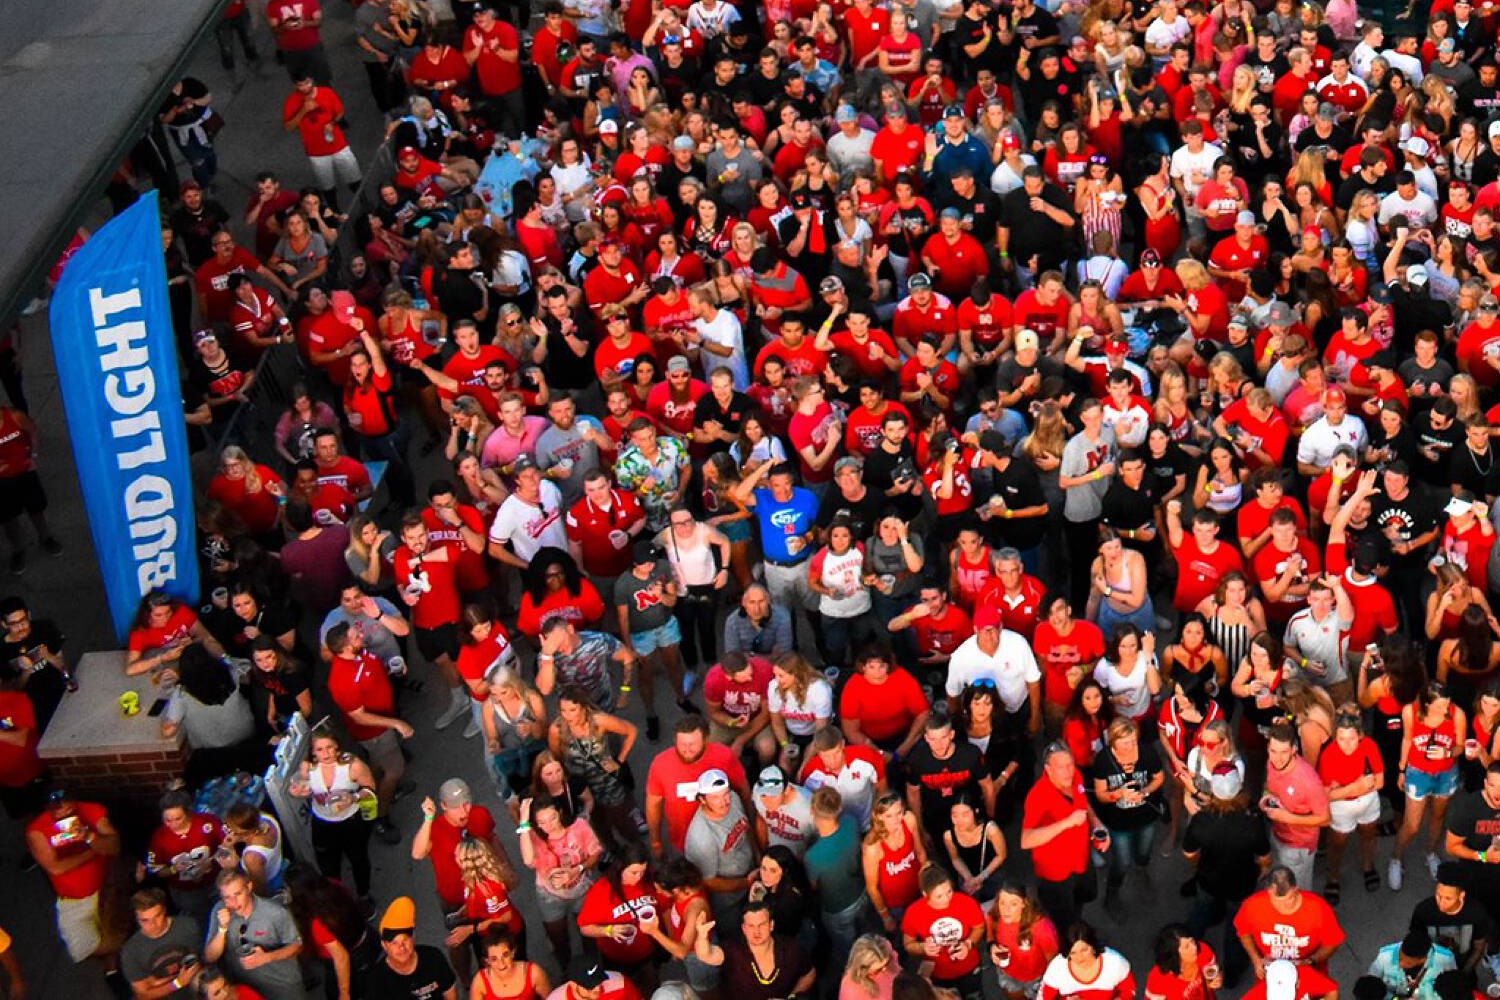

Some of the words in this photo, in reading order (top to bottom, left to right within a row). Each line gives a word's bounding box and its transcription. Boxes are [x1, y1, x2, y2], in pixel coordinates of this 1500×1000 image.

[88, 286, 167, 470] LIGHT
[123, 473, 178, 597] BUD
[1260, 931, 1310, 949] WELCOME
